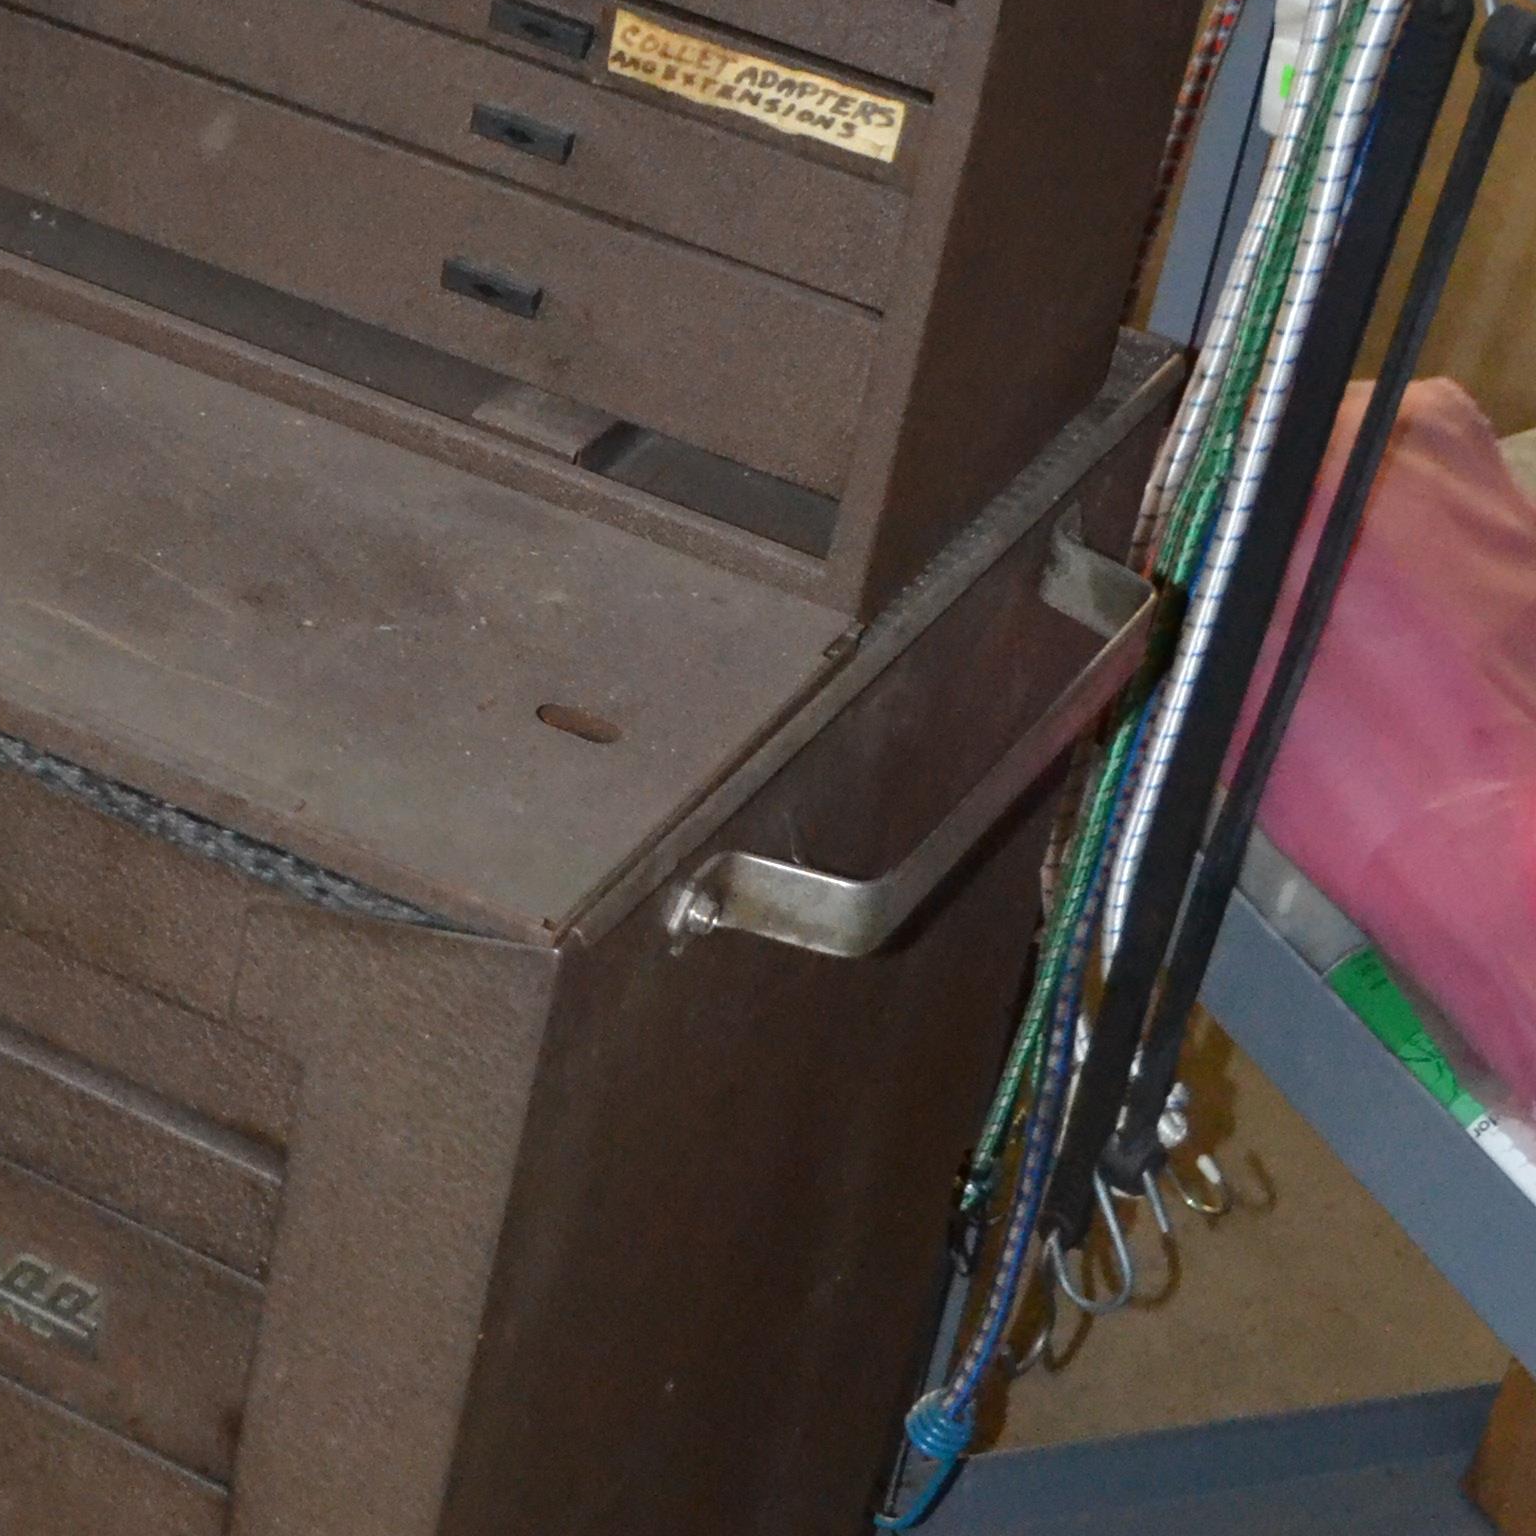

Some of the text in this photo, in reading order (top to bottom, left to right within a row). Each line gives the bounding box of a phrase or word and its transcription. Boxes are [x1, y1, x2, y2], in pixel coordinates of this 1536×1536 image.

[619, 24, 896, 129] COLLET ADAPTERS
[660, 70, 859, 139] EXTENSIONS
